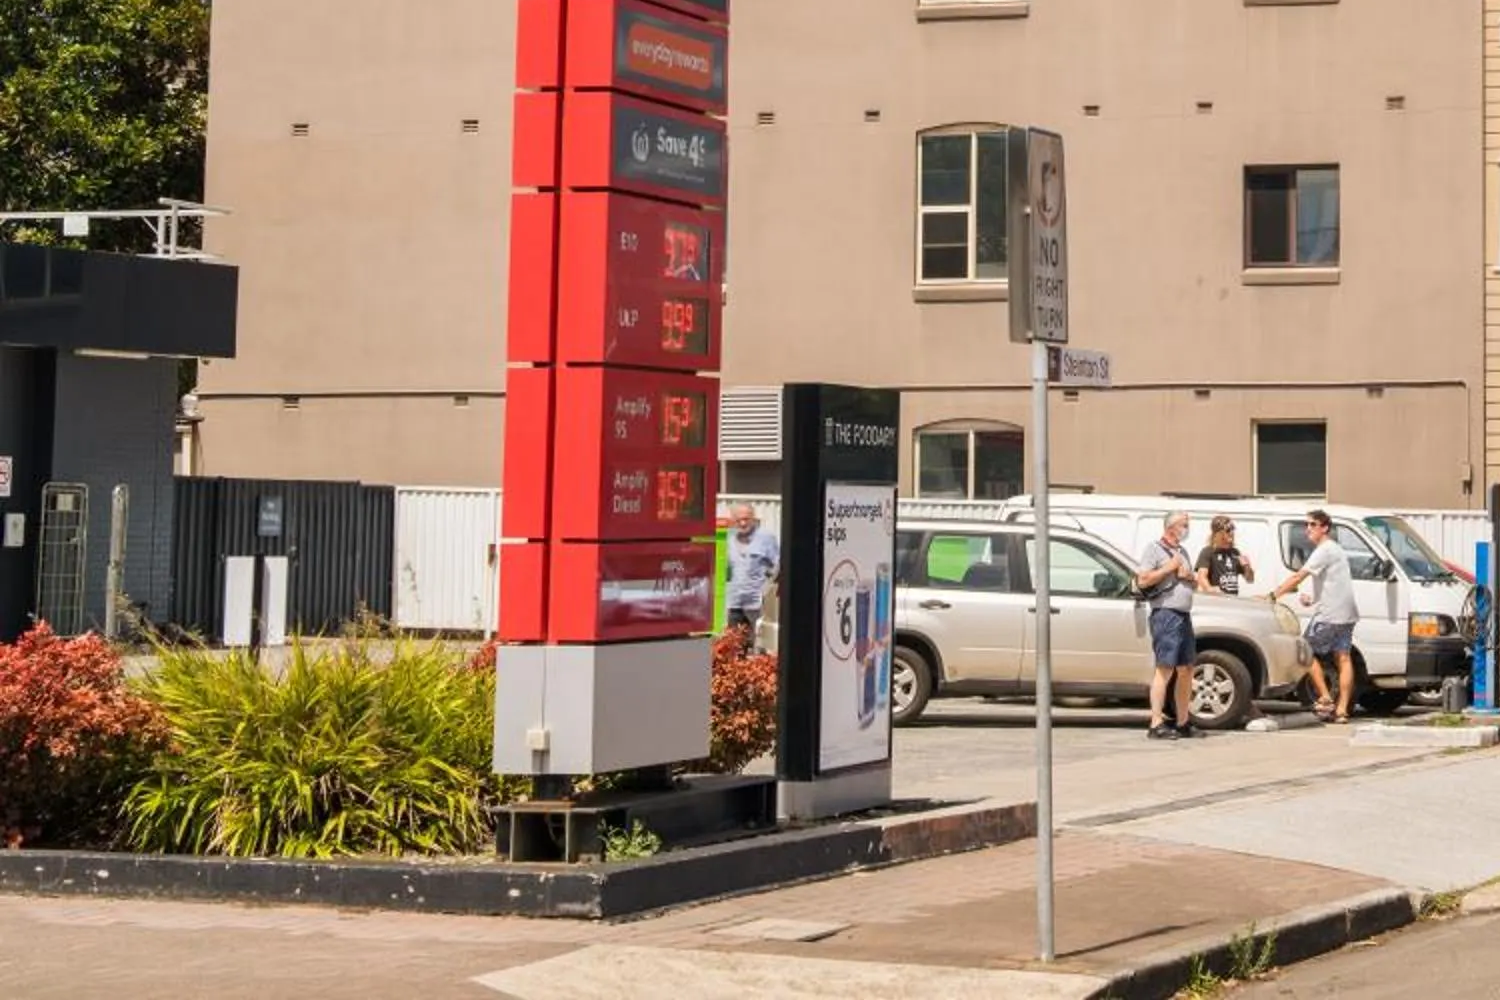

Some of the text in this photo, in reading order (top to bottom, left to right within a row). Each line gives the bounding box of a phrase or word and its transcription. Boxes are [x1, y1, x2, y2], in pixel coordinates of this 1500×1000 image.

[1039, 237, 1059, 268] NO
[1035, 275, 1064, 299] RIGHT
[1036, 305, 1064, 329] TURN
[835, 423, 851, 445] THE
[827, 521, 847, 545] sips
[835, 596, 851, 645] $6
